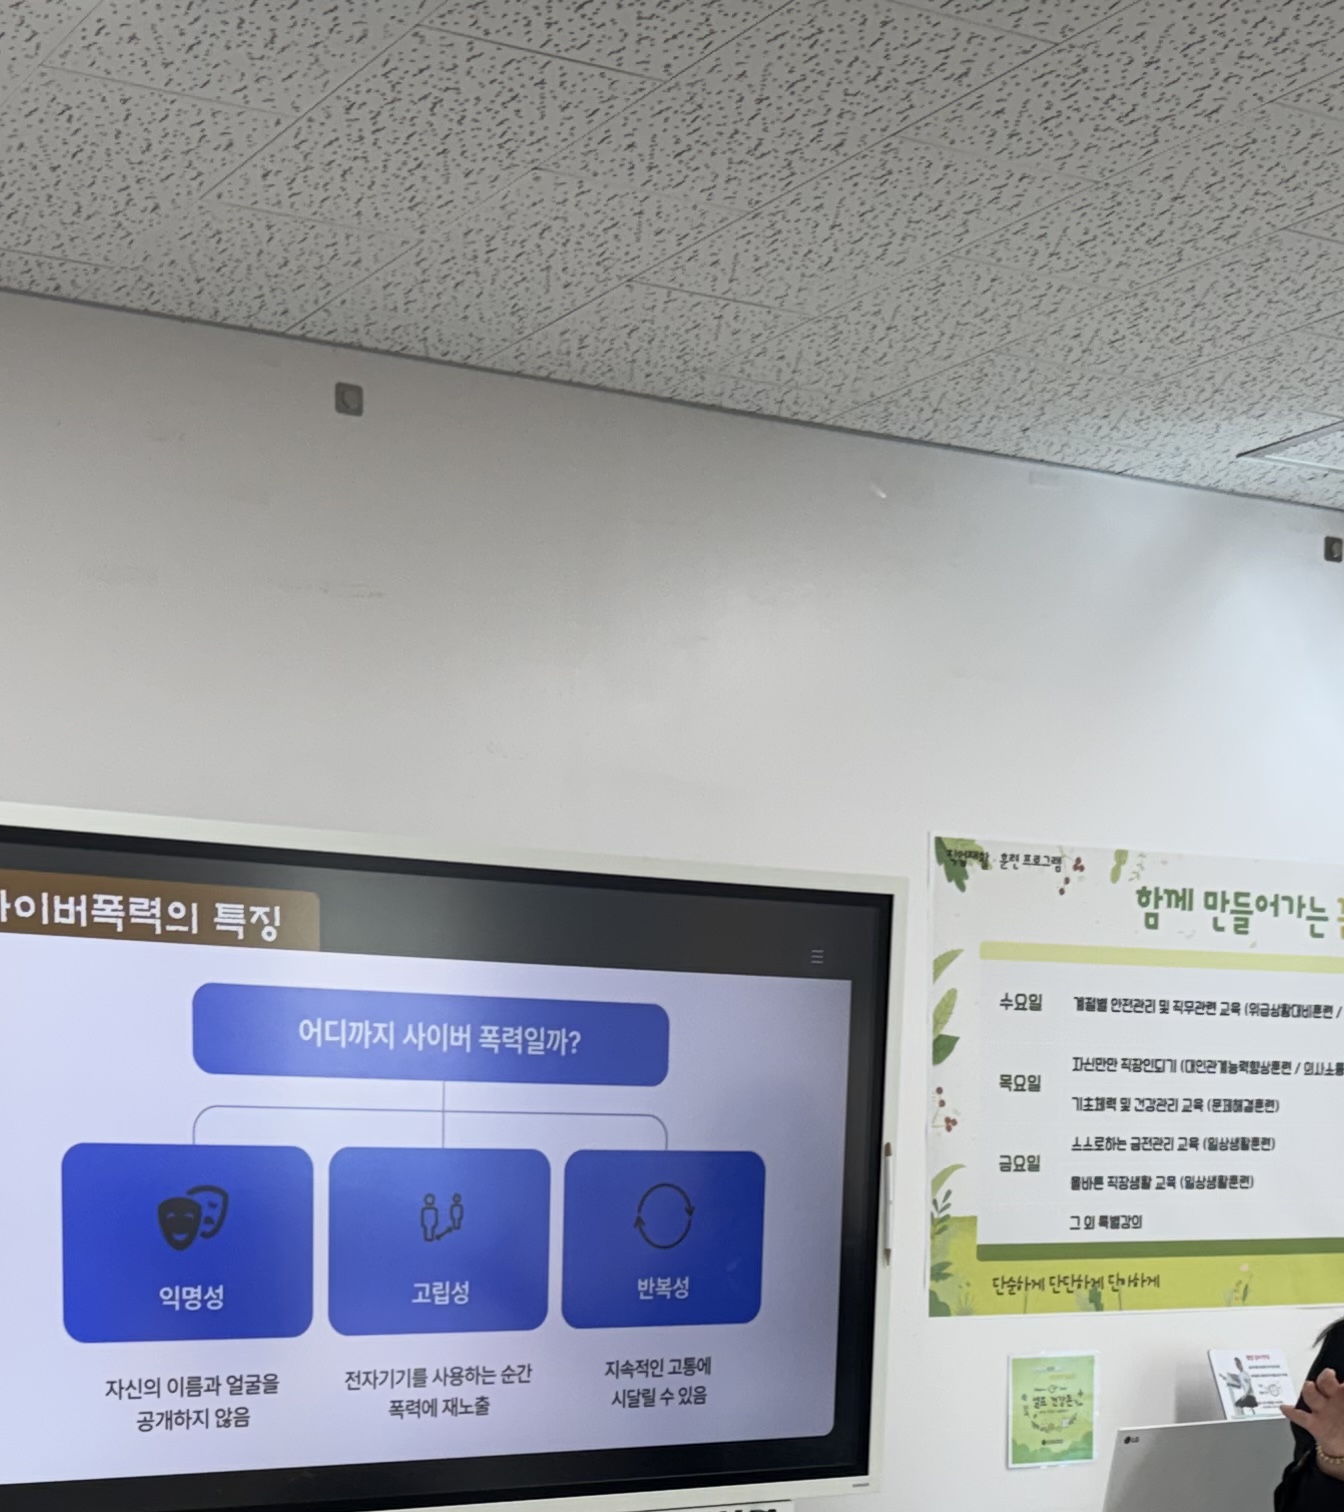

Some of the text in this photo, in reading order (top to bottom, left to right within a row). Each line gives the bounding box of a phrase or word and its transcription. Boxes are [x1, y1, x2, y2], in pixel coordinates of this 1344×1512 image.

[999, 853, 1020, 870] 훈련
[1022, 853, 1062, 873] 프로그램
[214, 902, 281, 942] 특징
[1136, 886, 1194, 929] 함께
[1203, 890, 1329, 938] 만들어가는
[999, 992, 1043, 1012] 수요일
[1110, 997, 1156, 1014] 안전관리
[1159, 999, 1169, 1015] 및
[1172, 1000, 1216, 1016] 직무관련
[1219, 1001, 1241, 1016] 교육
[299, 1017, 582, 1056] 어디까지 사이버 폭력일까?
[1072, 1056, 1118, 1073] 자신만만
[1121, 1057, 1177, 1074] 직장인되기
[999, 1074, 1042, 1092] 목요일
[1072, 1096, 1117, 1112] 기초체력
[1120, 1097, 1131, 1112] 및
[1134, 1098, 1178, 1113] 건강관리
[1181, 1098, 1204, 1113] 교육
[1070, 1136, 1127, 1152] 스스로하는
[1130, 1136, 1174, 1152] 금전관리
[1177, 1136, 1199, 1152] 교육
[999, 1154, 1041, 1172] 금요일
[1070, 1175, 1104, 1191] 올바른
[1107, 1175, 1152, 1191] 직장생활
[1155, 1176, 1176, 1191] 교육
[1069, 1215, 1143, 1231] 그 외 특별강의
[412, 1281, 470, 1305] 고립성
[637, 1276, 689, 1300] 반복성
[1049, 1273, 1104, 1294] 단단하게
[159, 1285, 224, 1311] 익명성
[345, 1363, 532, 1391] 전자기기를 사용하는 순간
[605, 1356, 712, 1379] 지속적인 고통에
[105, 1373, 280, 1400] 자신의 이름과 얼굴을
[611, 1385, 707, 1409] 시달릴 수 있음
[136, 1406, 250, 1432] 공개하지 않음
[388, 1396, 490, 1420] 폭력에 재노출
